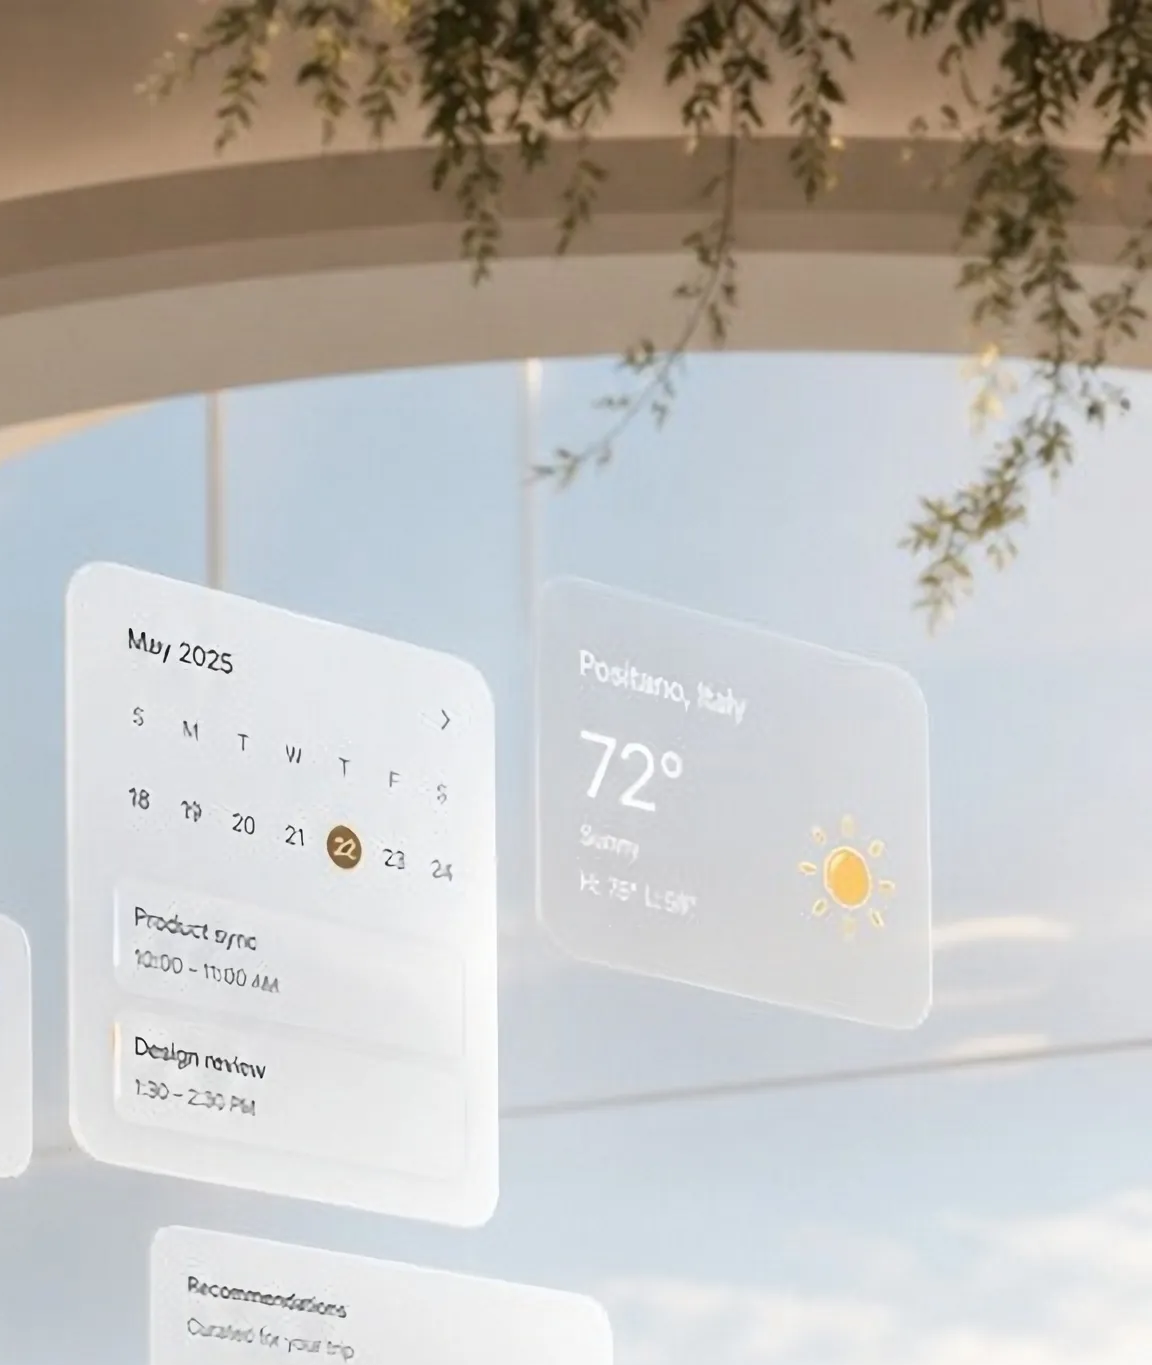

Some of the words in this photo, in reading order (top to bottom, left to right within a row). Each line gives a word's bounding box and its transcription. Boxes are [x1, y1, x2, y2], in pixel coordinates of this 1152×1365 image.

[179, 642, 233, 674] 2025
[133, 707, 144, 726] S
[183, 721, 198, 741] M
[237, 733, 249, 751] T
[339, 757, 350, 777] T
[389, 771, 400, 787] F
[580, 730, 682, 812] 72°
[129, 788, 149, 810] 18
[232, 813, 255, 835] 20
[285, 825, 304, 846] 21
[383, 849, 405, 869] 23
